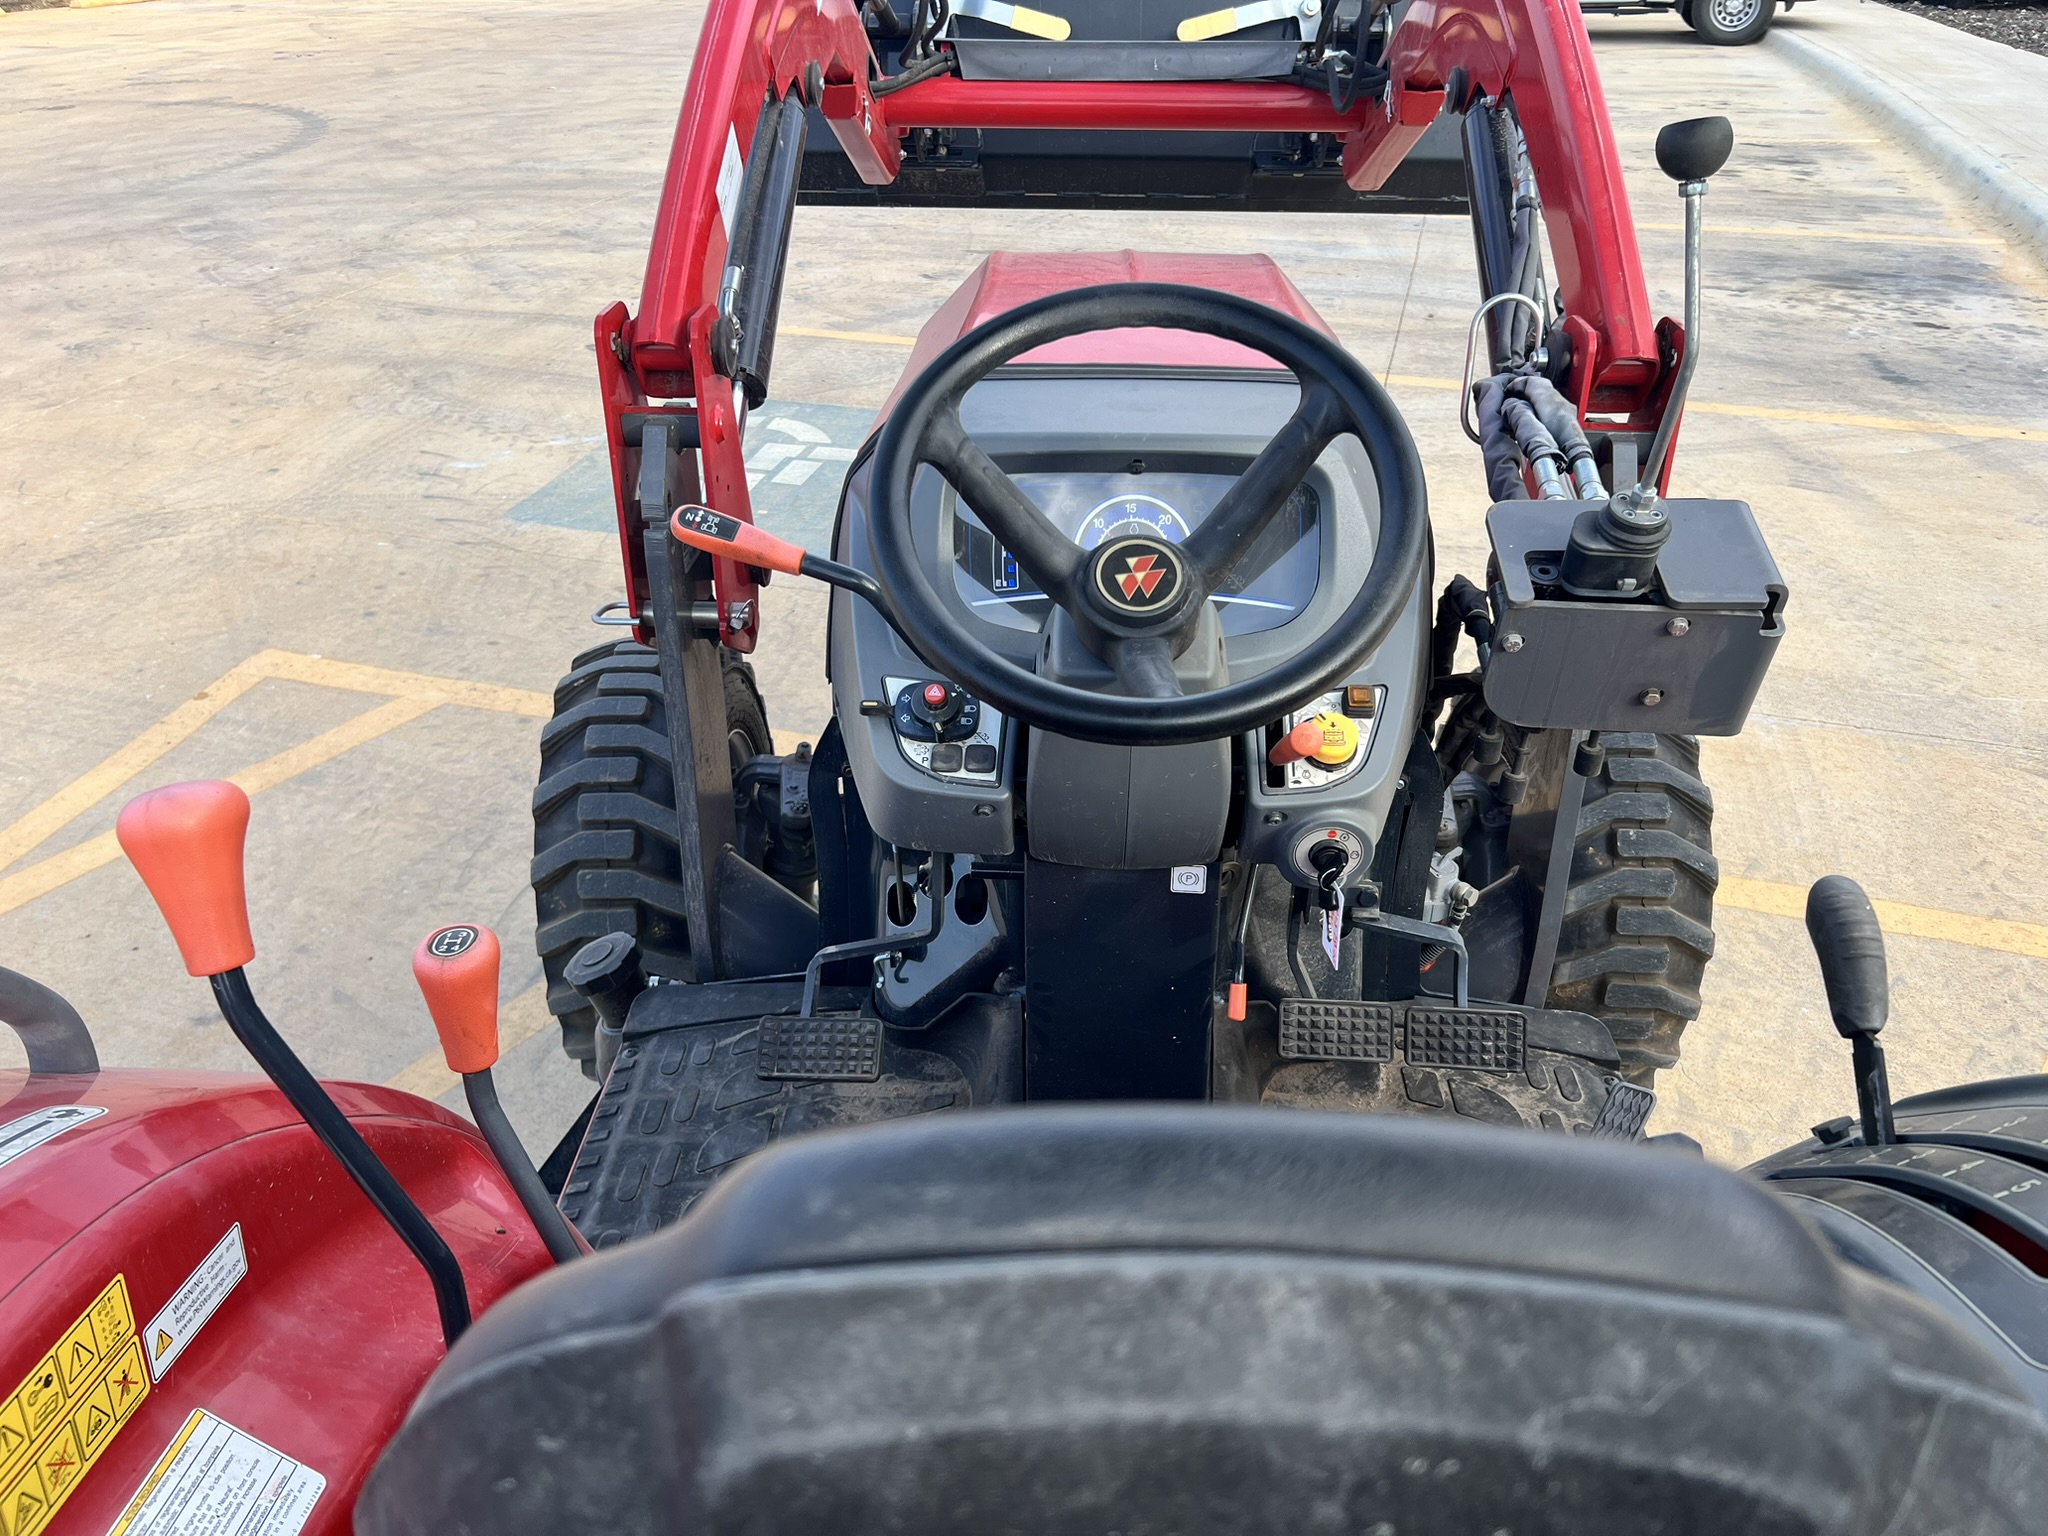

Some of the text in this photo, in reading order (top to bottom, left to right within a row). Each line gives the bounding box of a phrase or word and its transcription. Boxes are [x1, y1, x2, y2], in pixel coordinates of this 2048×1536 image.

[685, 512, 695, 521] N
[1093, 518, 1105, 528] 10
[1125, 503, 1137, 513] 15
[1158, 515, 1172, 525] 20
[206, 1252, 224, 1274] Cancer
[226, 1237, 236, 1253] and
[175, 1283, 209, 1326] Reproductive
[177, 1257, 241, 1337] www.P65Warnings.ca.gov
[123, 1501, 141, 1523] ACTION
[138, 1474, 160, 1501] REQUIRED
[143, 1474, 172, 1510] Regeneration
[158, 1508, 178, 1535] automatic
[176, 1475, 202, 1508] regeneration
[182, 1512, 198, 1532] engine
[195, 1493, 210, 1511] throttle
[211, 1473, 222, 1484] idle
[218, 1478, 257, 1535] automatically increase
[220, 1500, 234, 1518] button
[231, 1491, 240, 1500] on
[236, 1477, 248, 1491] front
[245, 1459, 260, 1478] console
[270, 1488, 294, 1521] immediately
[281, 1495, 299, 1519] confined
[295, 1480, 307, 1493] area
[153, 1520, 161, 1528] of
[196, 1512, 208, 1524] that
[204, 1503, 213, 1511] all
[206, 1514, 216, 1524] are
